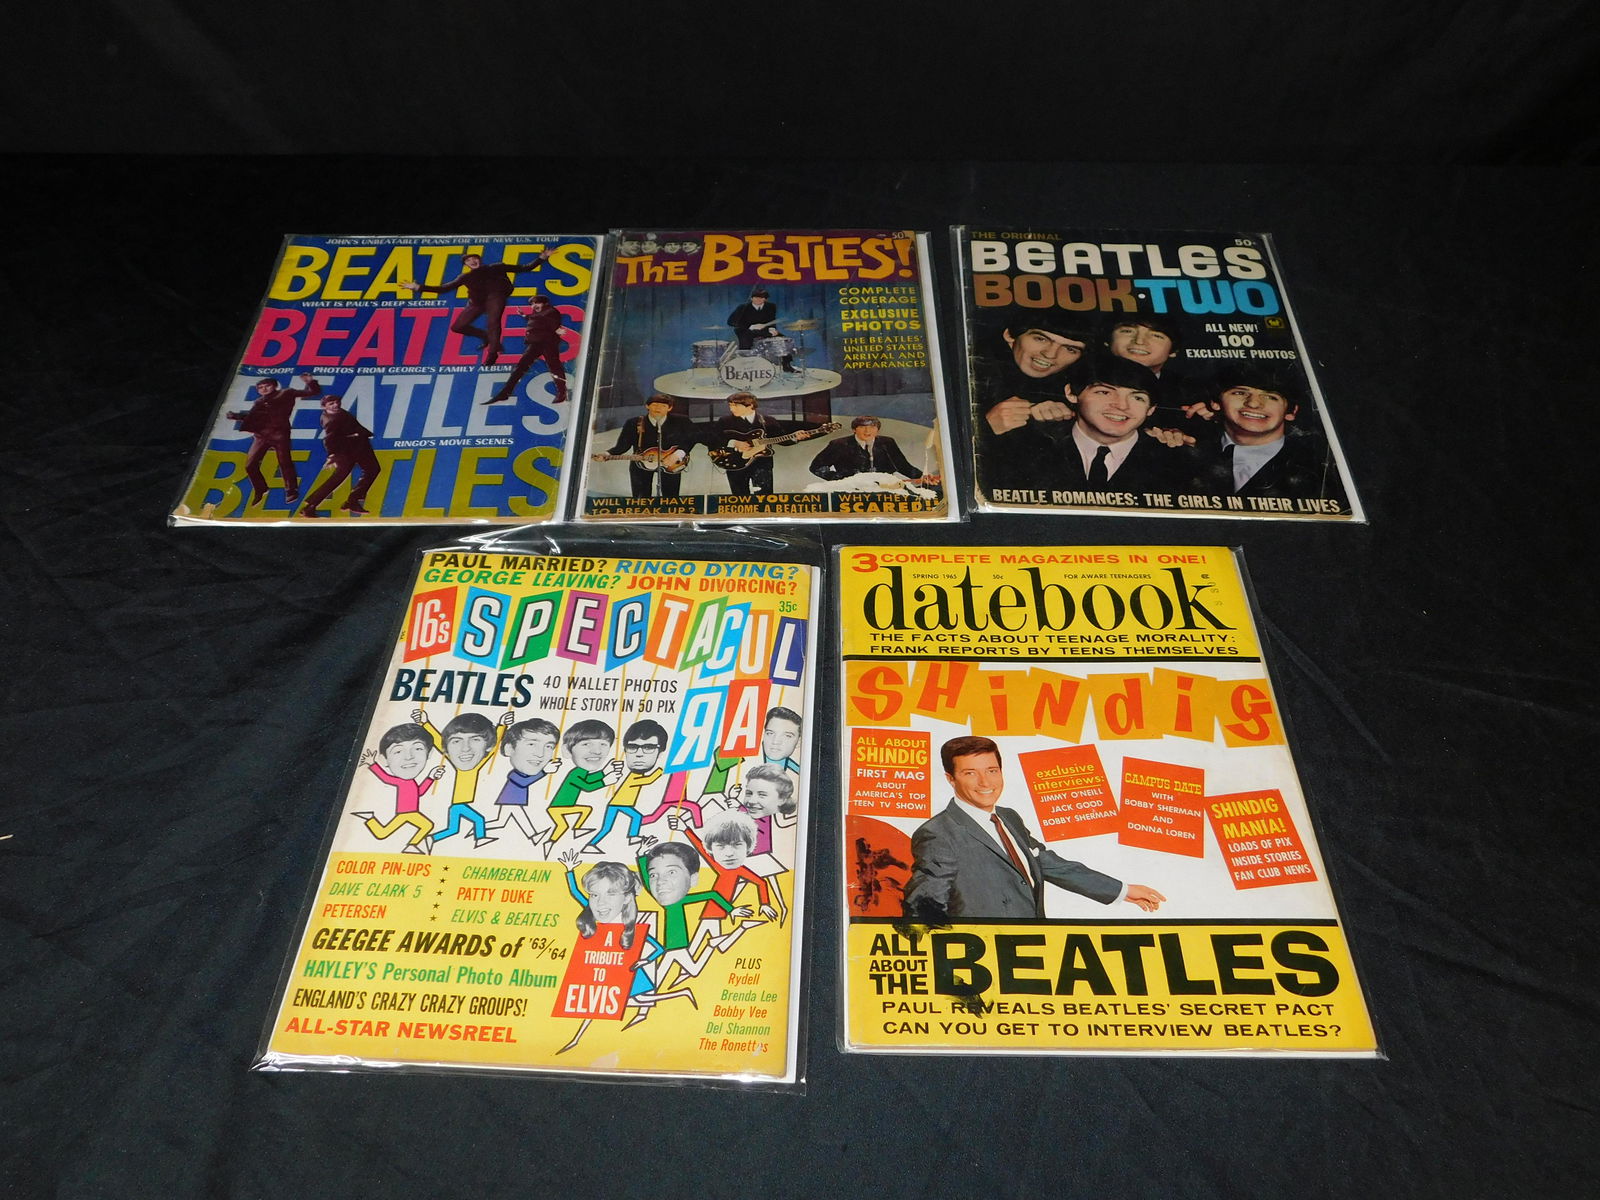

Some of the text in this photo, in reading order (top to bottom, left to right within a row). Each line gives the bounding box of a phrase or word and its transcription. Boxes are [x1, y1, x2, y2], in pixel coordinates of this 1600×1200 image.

[971, 240, 1267, 280] BEATLES
[839, 287, 916, 295] COMPLETE
[973, 273, 1279, 315] BOOK TWO
[840, 296, 917, 305] COVERAGE
[841, 309, 919, 320] EXCLUSIVE
[842, 321, 921, 332] PHOTOS
[1205, 324, 1259, 333] ALL NEW!
[1219, 335, 1254, 347] 100
[844, 353, 894, 361] ARRIVAL
[1186, 349, 1296, 360] EXCLUSIVE PHOTOS
[844, 361, 926, 369] APPEARANCES
[725, 366, 771, 381] BEATLES
[394, 439, 435, 447] RINGO'S
[593, 497, 695, 506] WILL THEY HAVE
[993, 489, 1340, 513] BEATLE ROMANCES: THE GIRLS IN THEIR LIVES
[881, 554, 1206, 564] COMPLETE MAGAZINES IN ONE!
[429, 554, 799, 580] PAUL MARRIED? RINGO DYING?
[423, 568, 797, 595] GEORGE LEAVING? JOHN DIVORCING?
[863, 565, 1237, 631] datebook
[870, 633, 1130, 643] THE FACTS ABOUT TEENAGE
[871, 646, 1239, 655] FRANK REPORTS BY TEENS THEMSELVES
[389, 668, 534, 709] BEATLES
[543, 676, 678, 693] 40 WALLET PHOTOS
[540, 696, 676, 713] WHOLE STORY IN 50 PIX
[857, 736, 927, 748] ALL ABOUT
[857, 747, 927, 765] SHINDIG
[1036, 763, 1095, 778] exclusive
[1125, 773, 1202, 794] CAMPUS DATE
[855, 790, 926, 800] AMERICA'S TOP
[896, 802, 926, 810] SHOW!
[1211, 797, 1279, 819] SHINDIG
[1043, 810, 1118, 826] BOBBY SHERMAN
[1128, 822, 1195, 839] DONNA LOREN
[1223, 818, 1287, 839] MANIA!
[1231, 851, 1301, 867] INSIDE STORIES
[336, 860, 432, 877] COLOR PIN-UPS
[462, 866, 552, 883] CHAMBERLAIN
[1234, 864, 1311, 881] FAN CLUB NEWS
[329, 883, 409, 898] DAVE CLARK
[457, 887, 535, 904] PATTY DUKE
[323, 904, 387, 919] PETERSEN
[451, 909, 560, 927] ELVIS BEATLES
[312, 928, 525, 958] GEEGEE AWARDS of
[584, 951, 624, 966] TRIBUTE
[735, 958, 762, 970] PLUS
[931, 930, 1339, 997] BEATLES
[303, 960, 557, 988] HAYLEY'S Personal Photo Album
[728, 973, 760, 987] Rydell
[292, 988, 528, 1017] ENGLAND'S CRAZY CRAZY GROUPS!
[564, 984, 621, 1015] ELVIS
[721, 990, 778, 1003] Brenda Lee
[713, 1005, 767, 1020] Bobby Vee
[883, 1001, 1334, 1015] PAUL SECRET PACT
[285, 1017, 517, 1043] ALL-STAR NEWSREEL
[706, 1022, 770, 1035] Del Shannon
